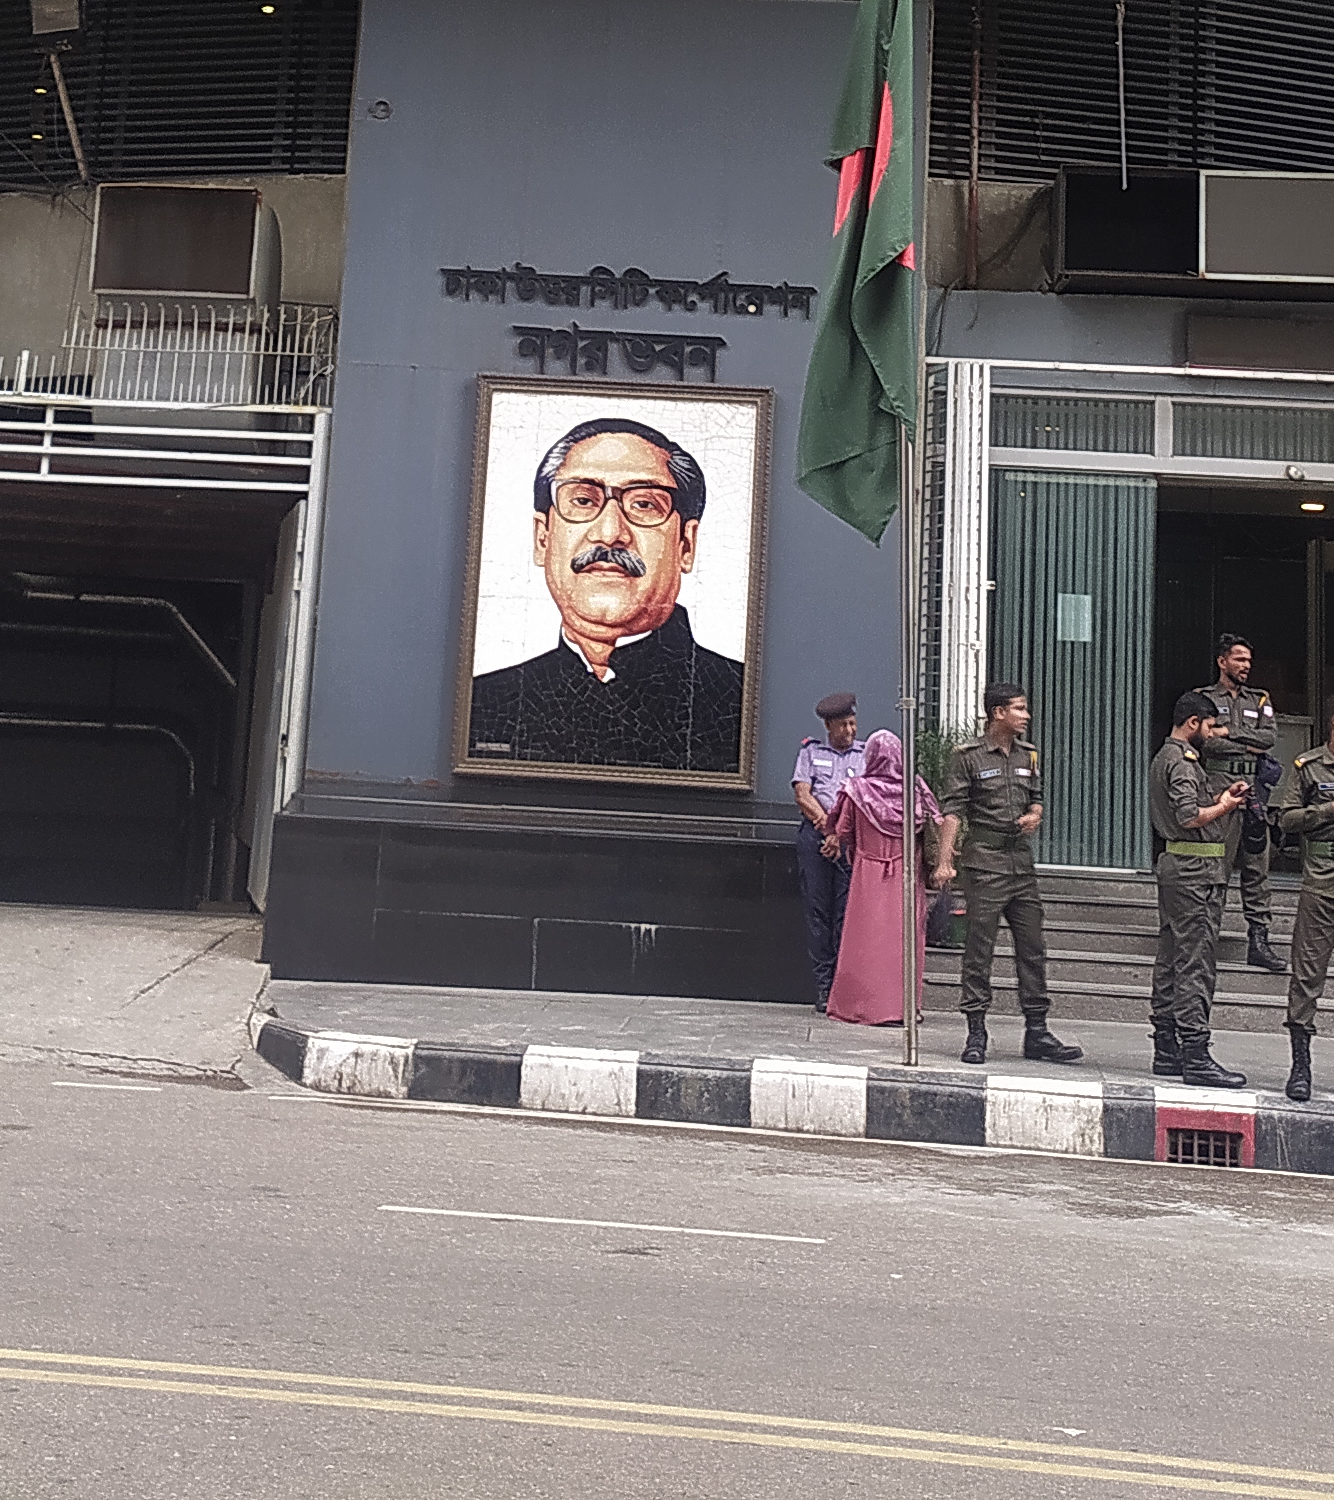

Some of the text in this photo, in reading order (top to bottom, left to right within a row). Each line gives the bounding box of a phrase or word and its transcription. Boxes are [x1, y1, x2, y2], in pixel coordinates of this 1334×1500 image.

[440, 265, 507, 304] ঢাকা
[507, 261, 581, 308] উত্তর
[587, 265, 651, 311] সিটি
[512, 321, 728, 383] নগর ভবন
